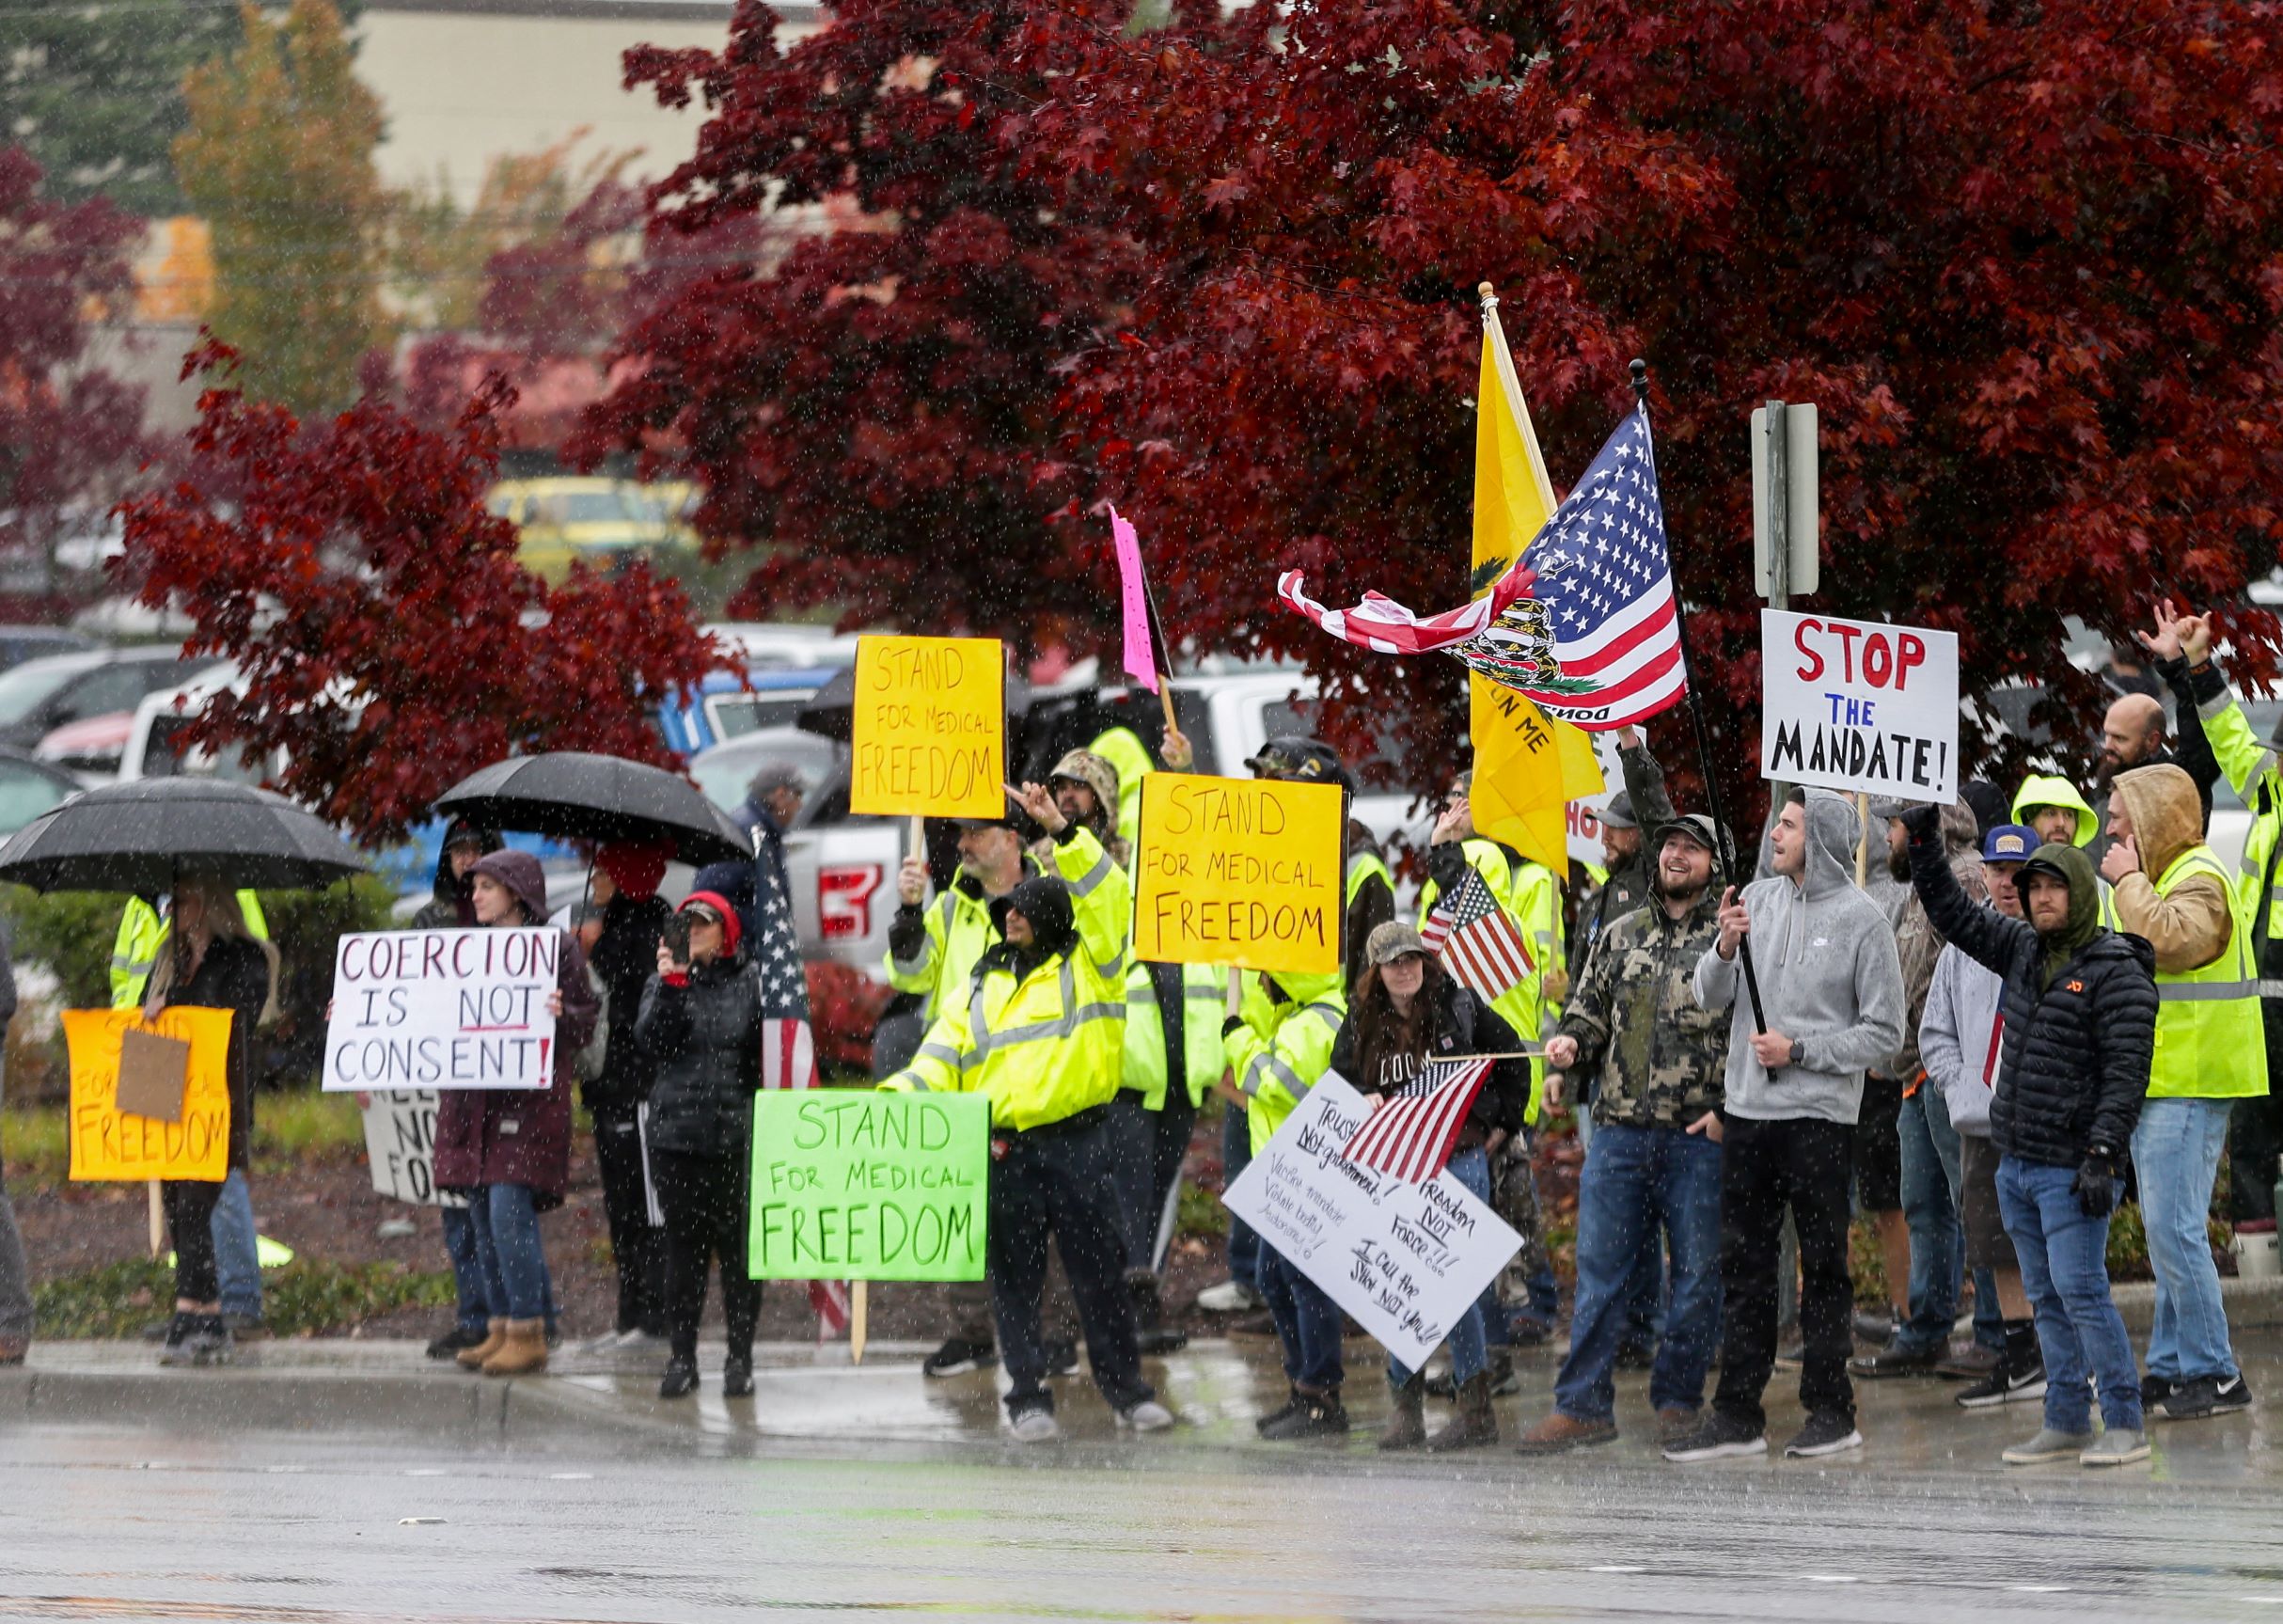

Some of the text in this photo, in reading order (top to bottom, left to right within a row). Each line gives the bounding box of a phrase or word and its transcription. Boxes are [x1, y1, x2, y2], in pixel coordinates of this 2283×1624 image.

[873, 646, 964, 691] STAND
[1794, 618, 1926, 691] STOP
[876, 704, 994, 734] FOR MEDICAL
[1824, 693, 1876, 726] THE
[1515, 717, 1551, 755] ME
[1771, 717, 1947, 792] MANDATE!
[860, 742, 995, 801] FREEDOM
[1165, 783, 1285, 835] STAND
[1146, 846, 1325, 888] FOR MEDICAL
[1155, 891, 1325, 954] FREEDOM
[340, 931, 557, 983] COERCION
[355, 984, 542, 1031] IS NOT
[335, 1036, 551, 1087] CONSENT!
[77, 1103, 225, 1169] FREEDOM
[794, 1098, 952, 1151] STAND
[770, 1159, 974, 1194] FOR MEDICAL
[762, 1200, 975, 1267] FREEDOM
[1418, 1206, 1456, 1244] NOT
